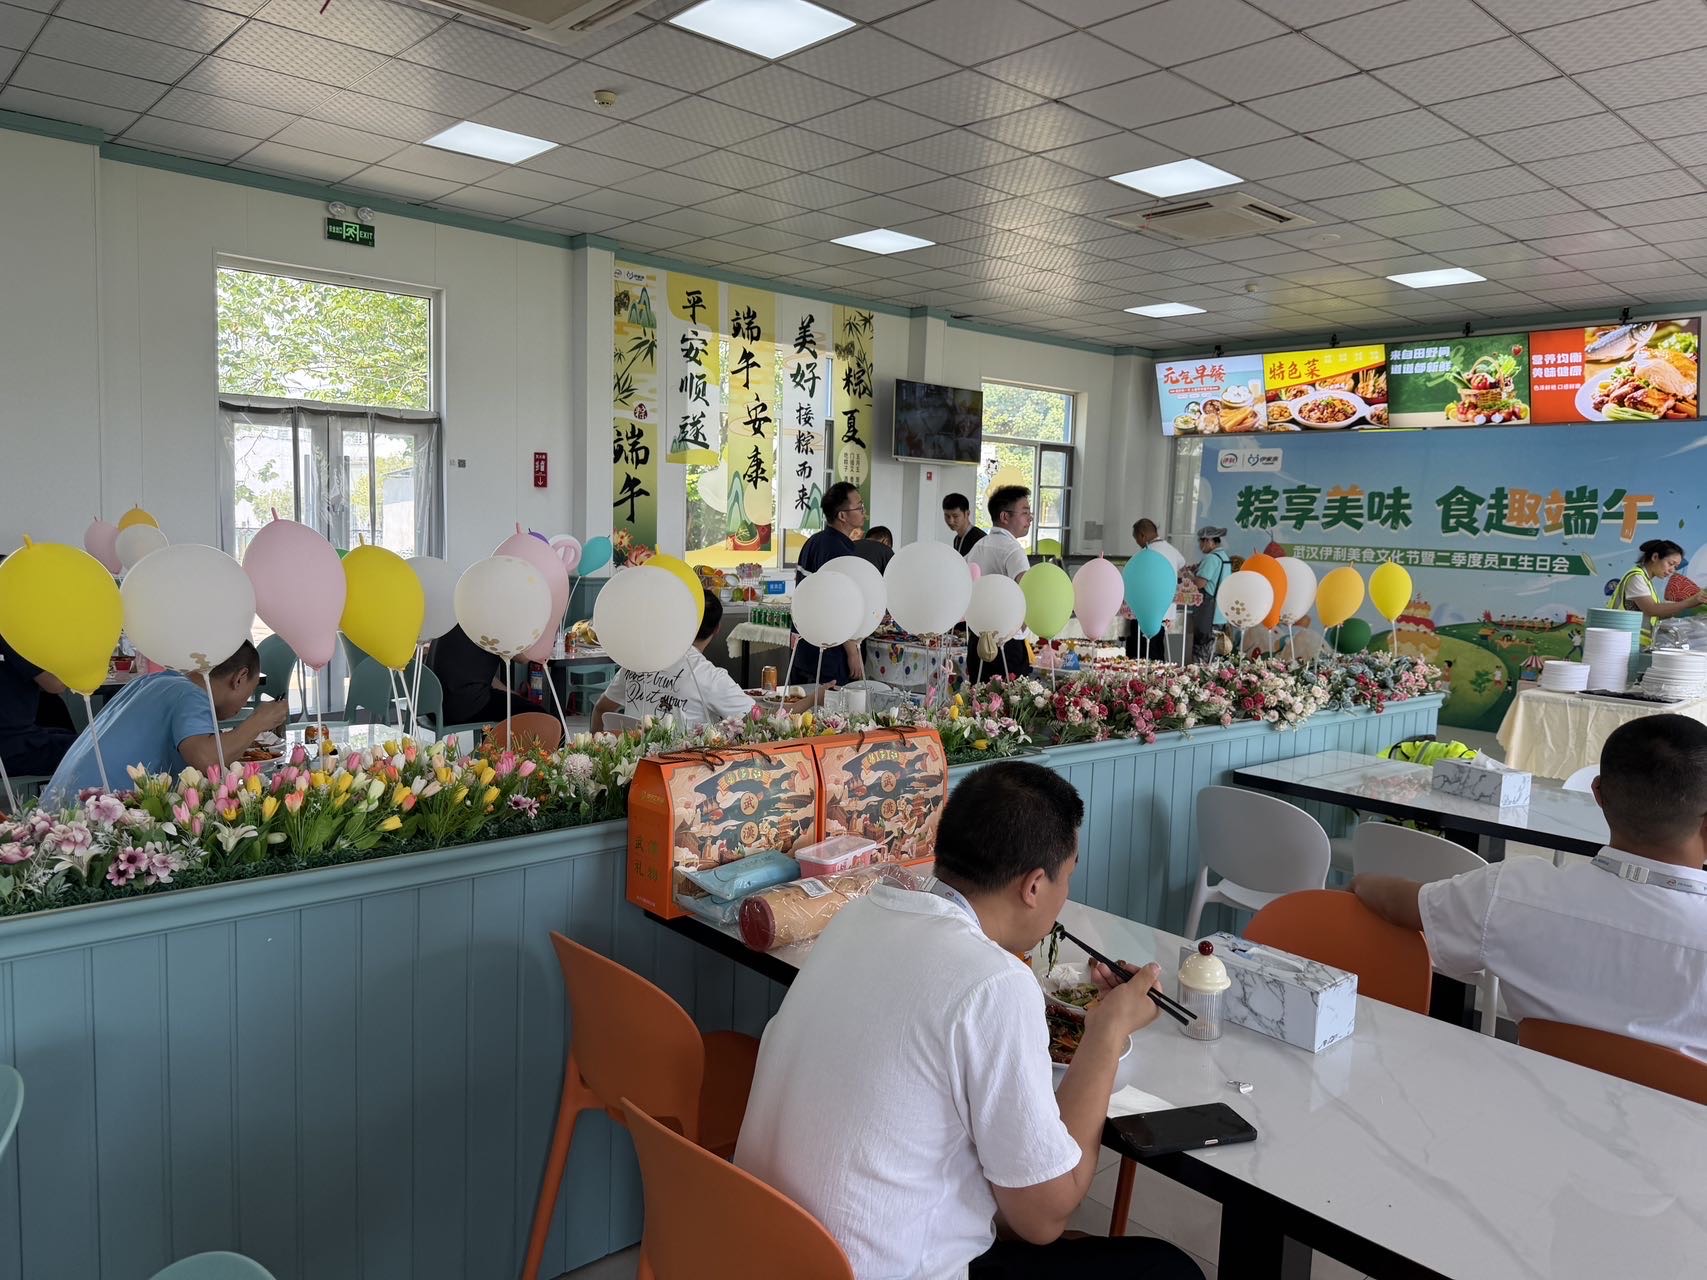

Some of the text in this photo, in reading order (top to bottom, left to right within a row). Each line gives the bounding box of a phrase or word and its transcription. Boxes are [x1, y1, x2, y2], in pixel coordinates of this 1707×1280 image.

[359, 231, 373, 240] EXIT
[679, 289, 710, 450] 平安顺遂
[1163, 364, 1227, 386] 元气早餐
[1269, 358, 1321, 381] 特色菜
[1531, 365, 1583, 378] 美味健康
[731, 305, 772, 490] 端午安康
[790, 314, 822, 511] 美好接粽而来
[613, 422, 651, 524] 端午
[1235, 483, 1659, 544] 粽享美味 食趣端午
[1292, 545, 1570, 574] 武汉伊利美食文化节暨二季度员工生日会
